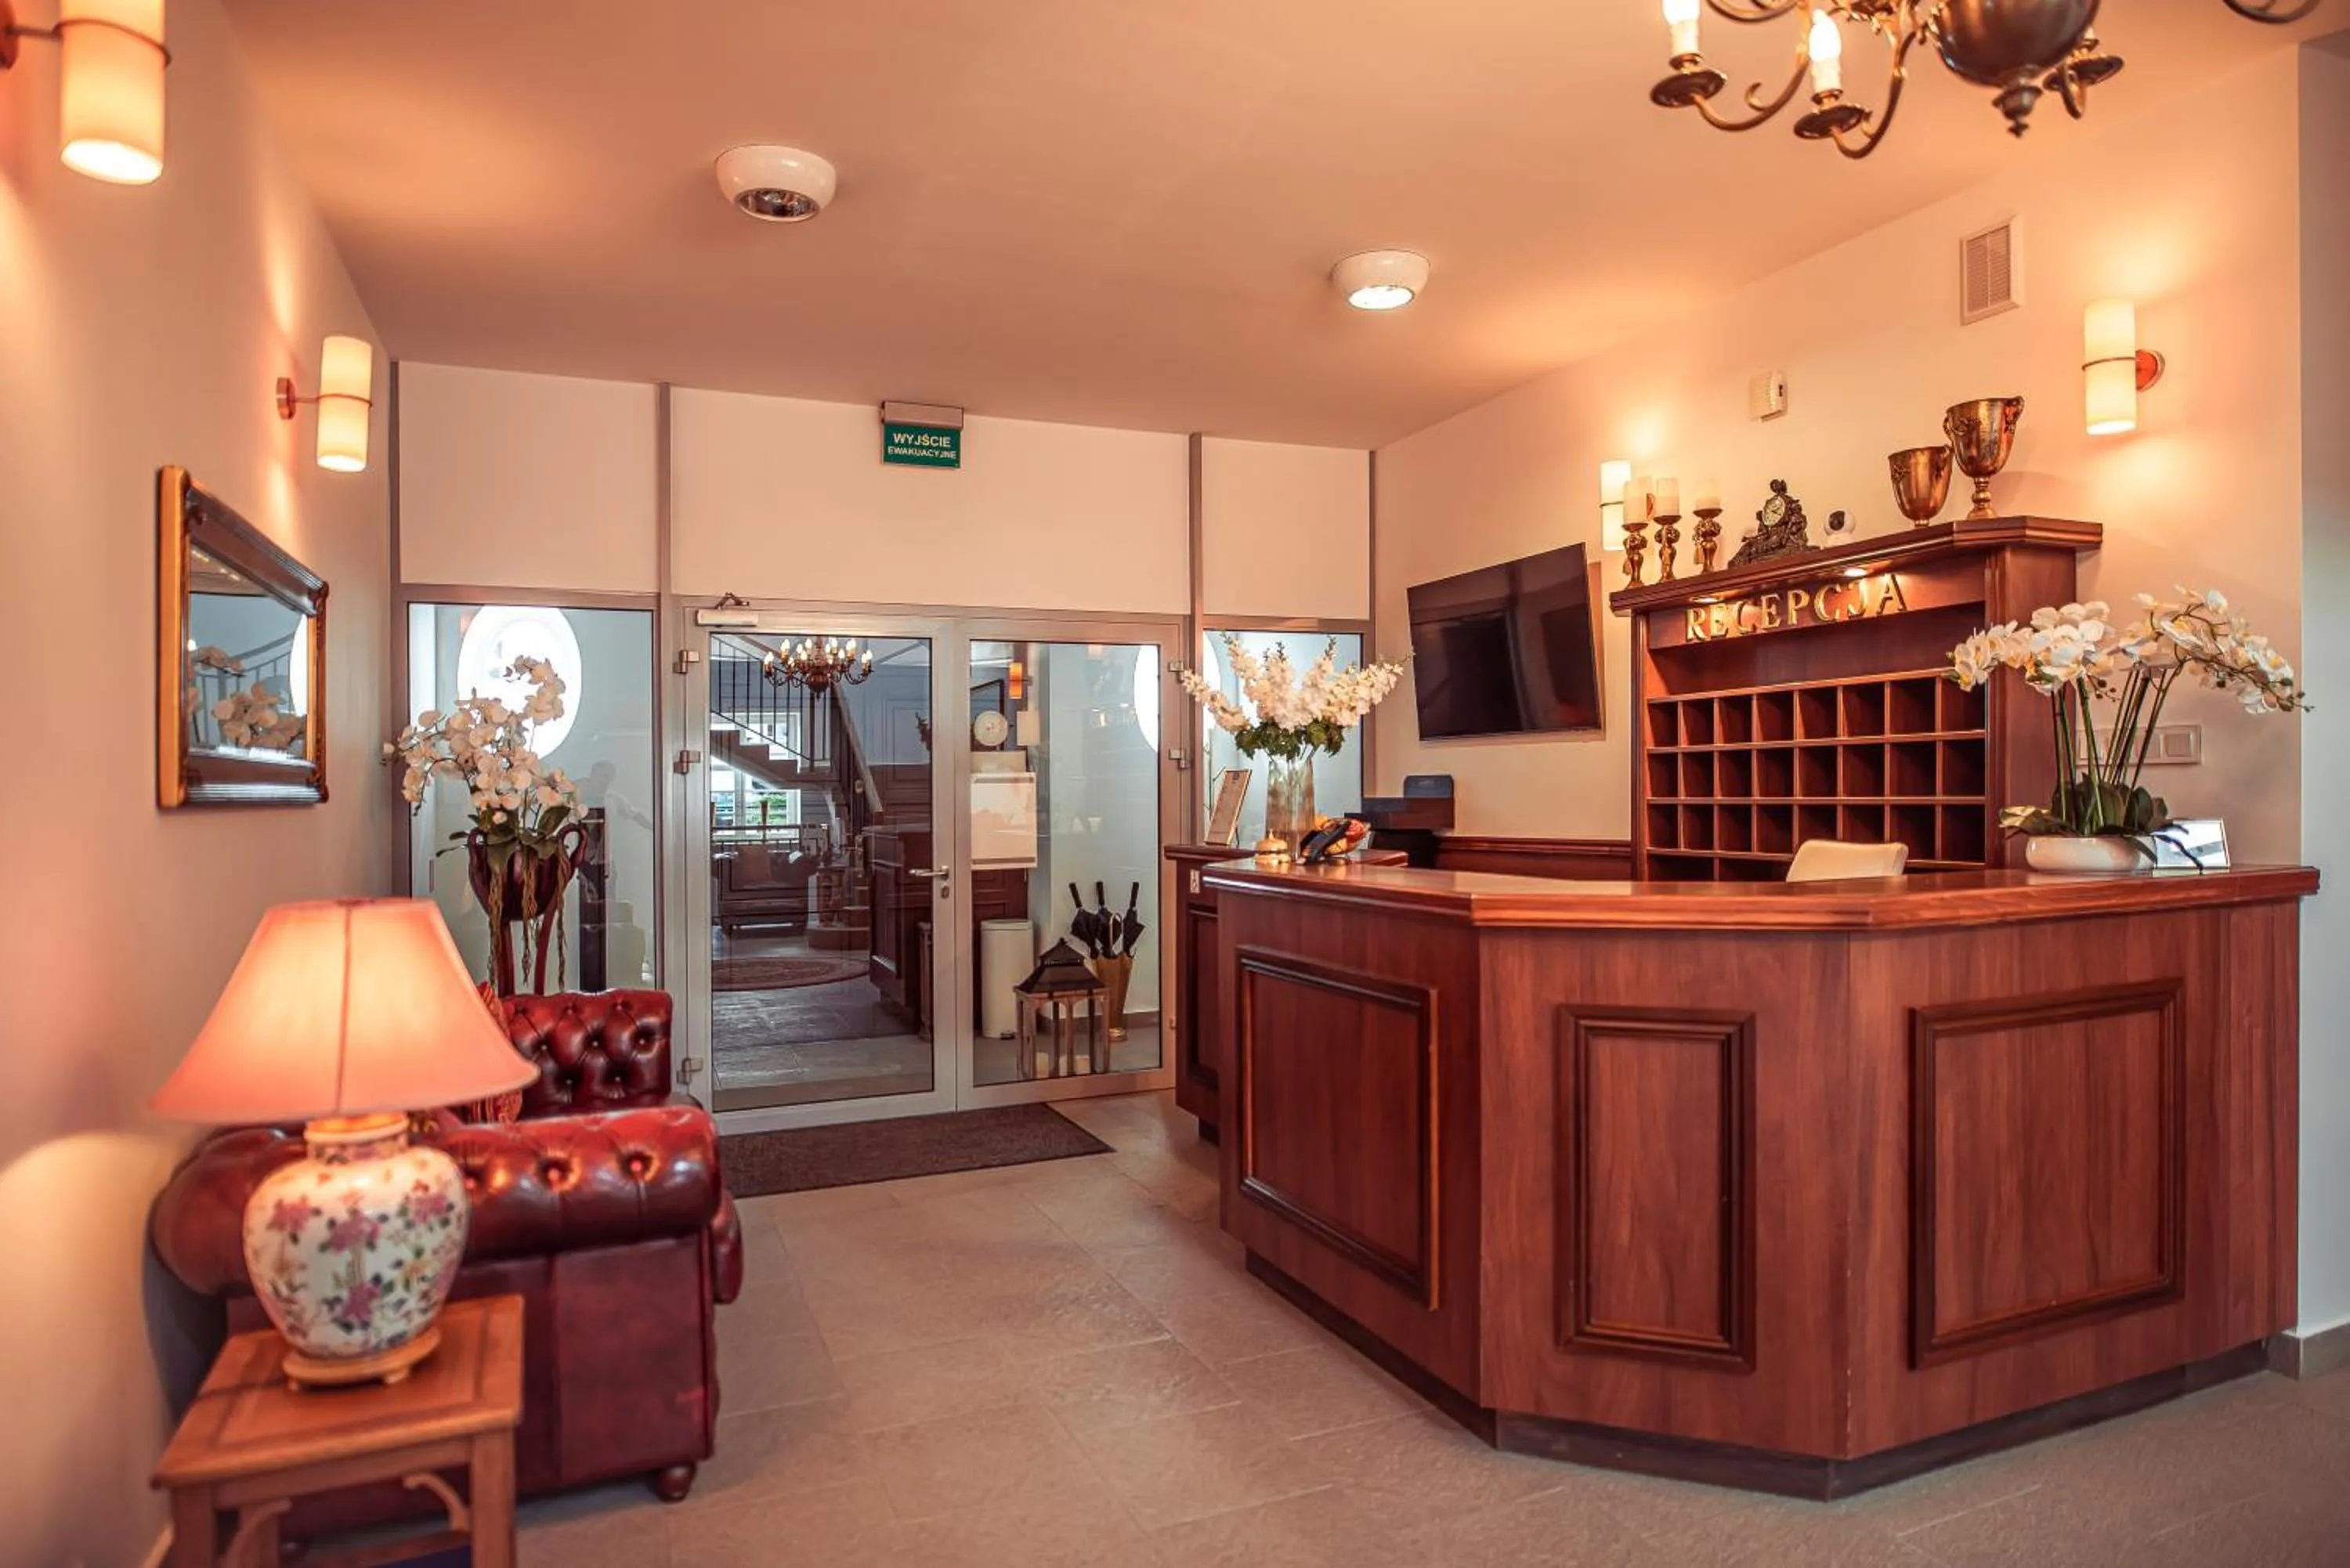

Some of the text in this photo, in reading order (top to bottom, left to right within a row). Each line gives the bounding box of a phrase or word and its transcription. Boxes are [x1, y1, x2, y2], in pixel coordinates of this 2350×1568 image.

[893, 432, 952, 448] WYJŚCIE
[888, 446, 957, 460] EWAKUACYJNE
[1686, 573, 1908, 641] RECEPCJA
